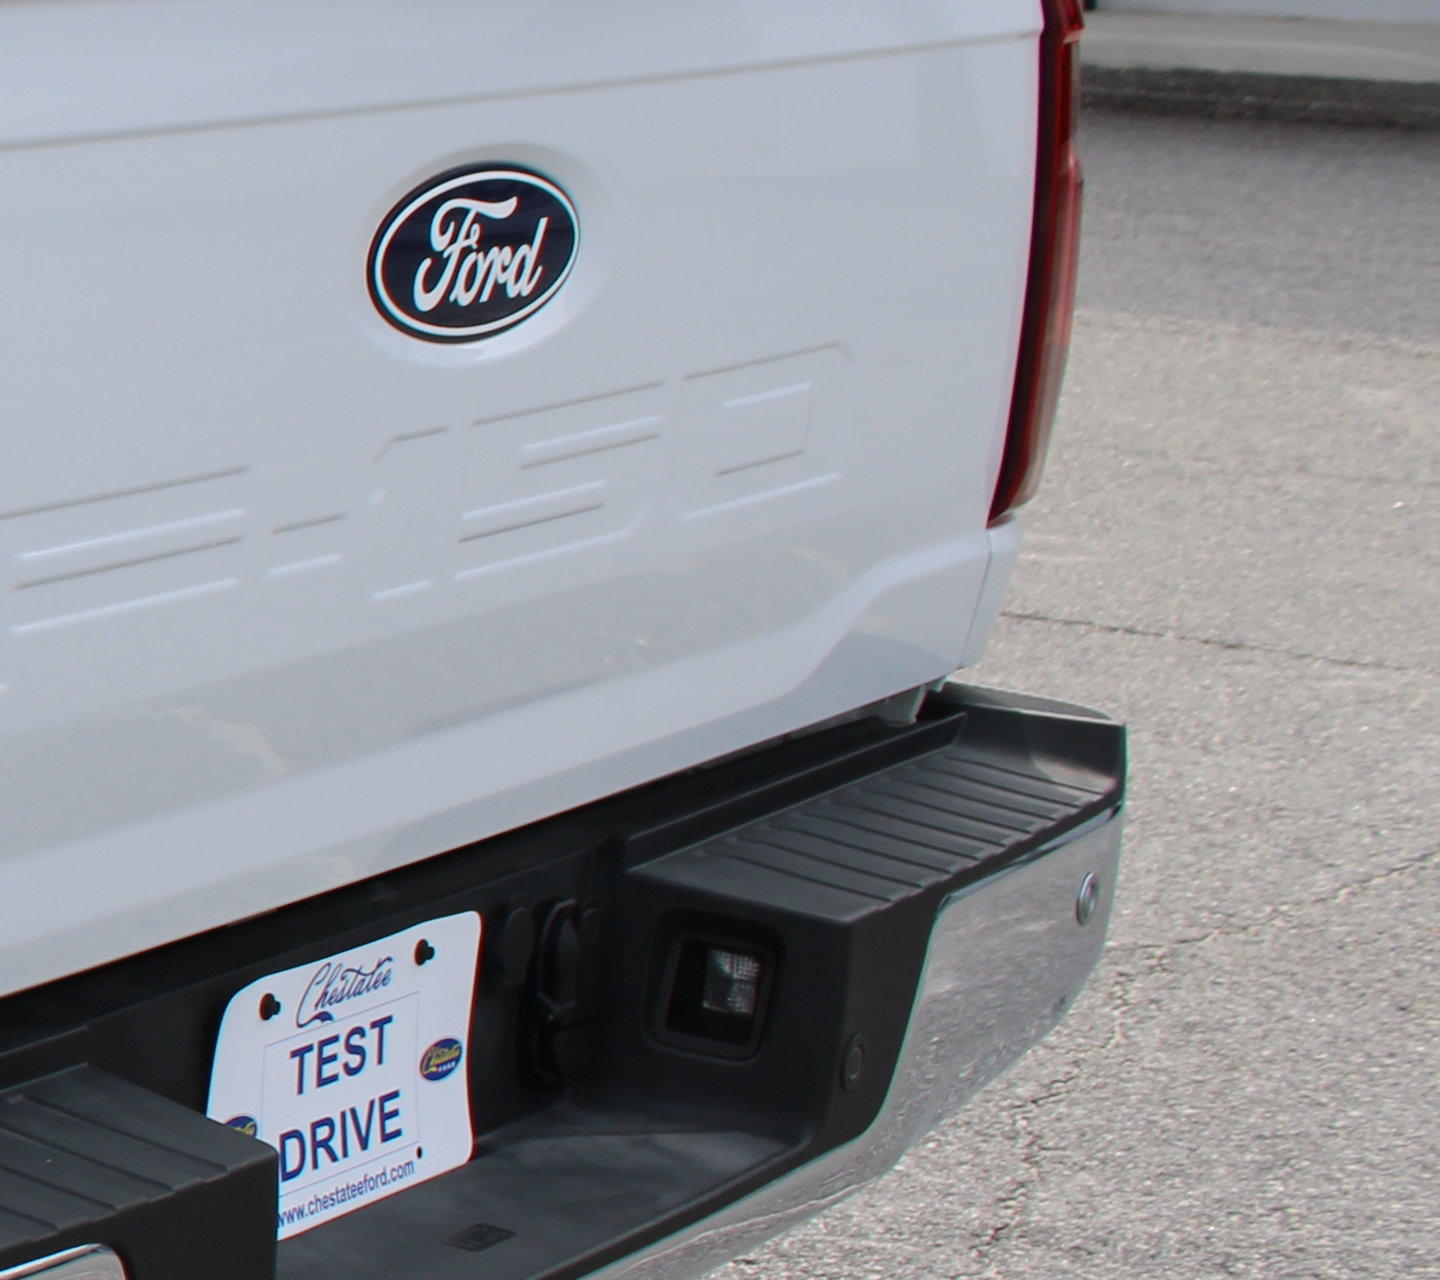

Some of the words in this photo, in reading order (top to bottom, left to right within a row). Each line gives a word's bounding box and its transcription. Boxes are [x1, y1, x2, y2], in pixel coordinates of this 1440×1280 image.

[413, 195, 550, 313] Ford
[295, 956, 394, 1028] Chestatee
[289, 1014, 394, 1096] TEST
[279, 1089, 403, 1183] DRIVE
